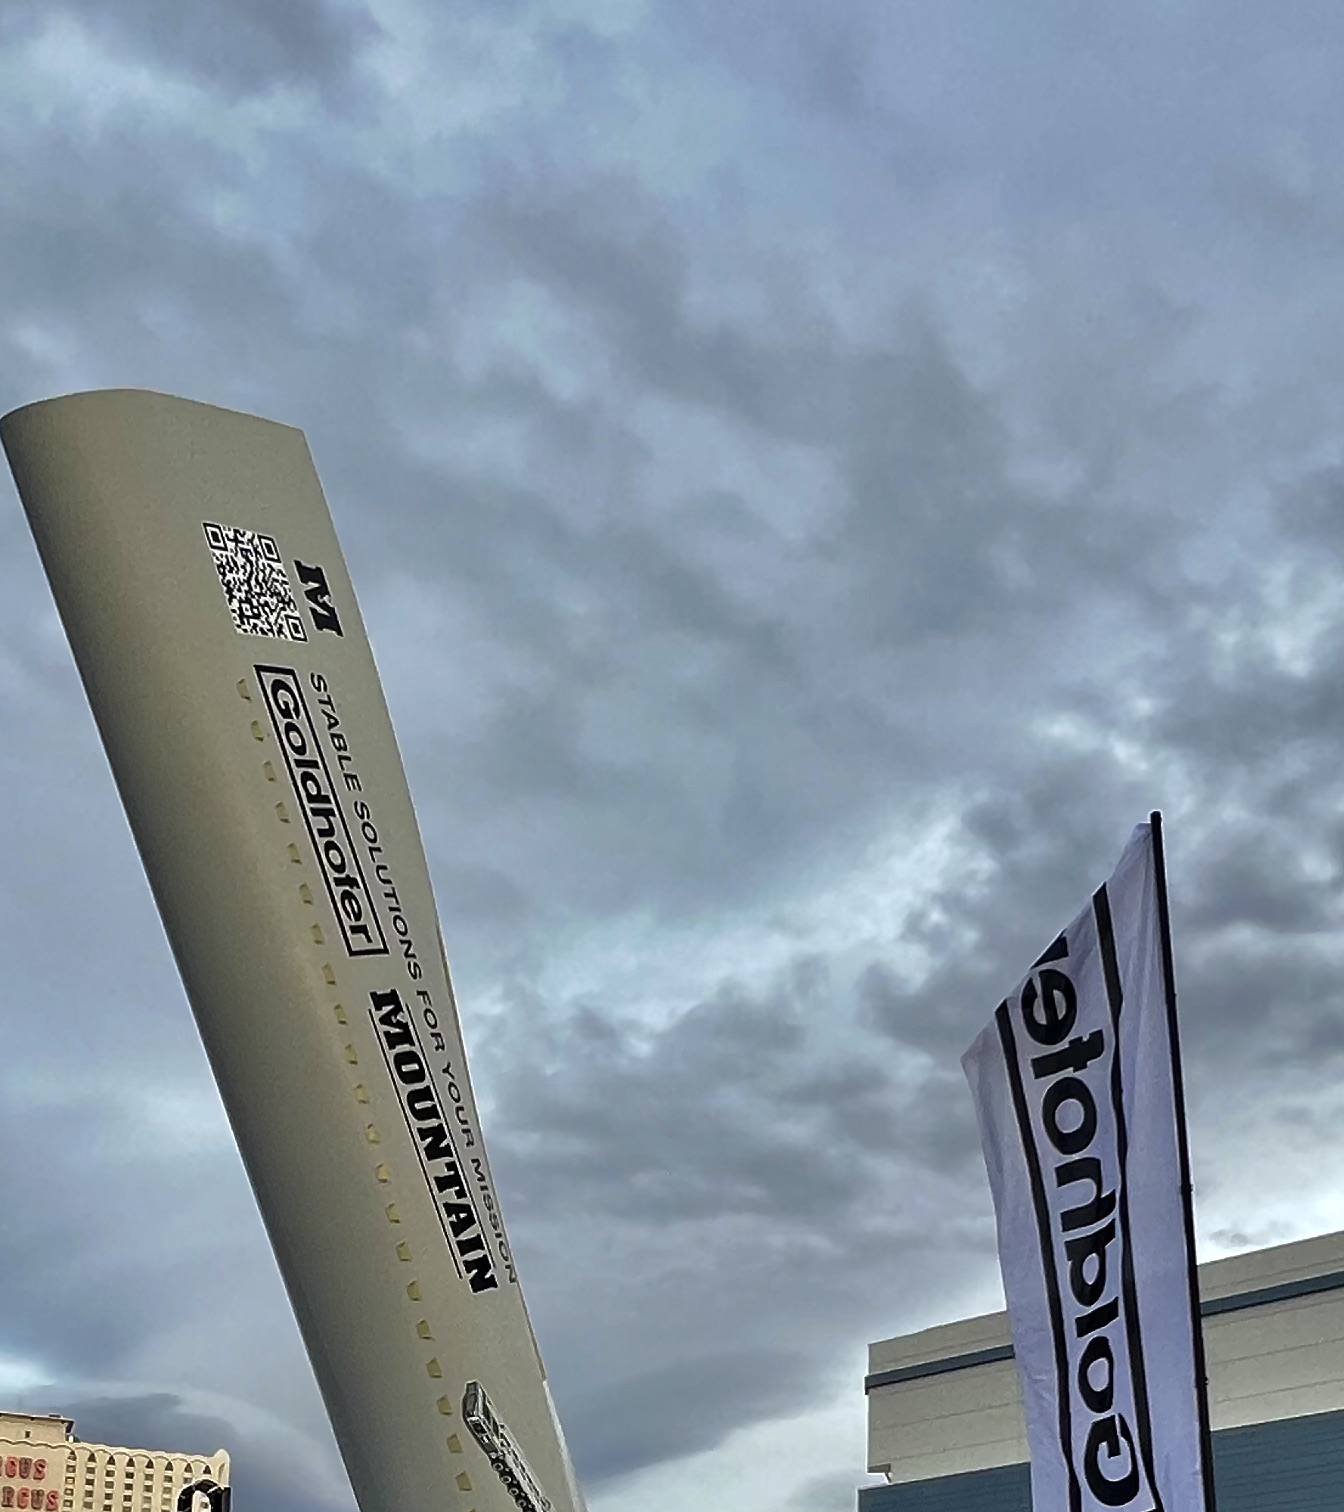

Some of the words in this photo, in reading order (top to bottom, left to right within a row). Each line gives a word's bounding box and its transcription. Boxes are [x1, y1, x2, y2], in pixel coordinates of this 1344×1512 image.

[269, 677, 373, 946] Goldhofer
[310, 671, 362, 792] STABLE
[354, 800, 422, 981] SOLUTIONS
[416, 989, 446, 1052] FOR
[441, 1062, 476, 1148] YOUR
[470, 1158, 518, 1284] MISSION
[369, 988, 499, 1293] MOUNTAIN
